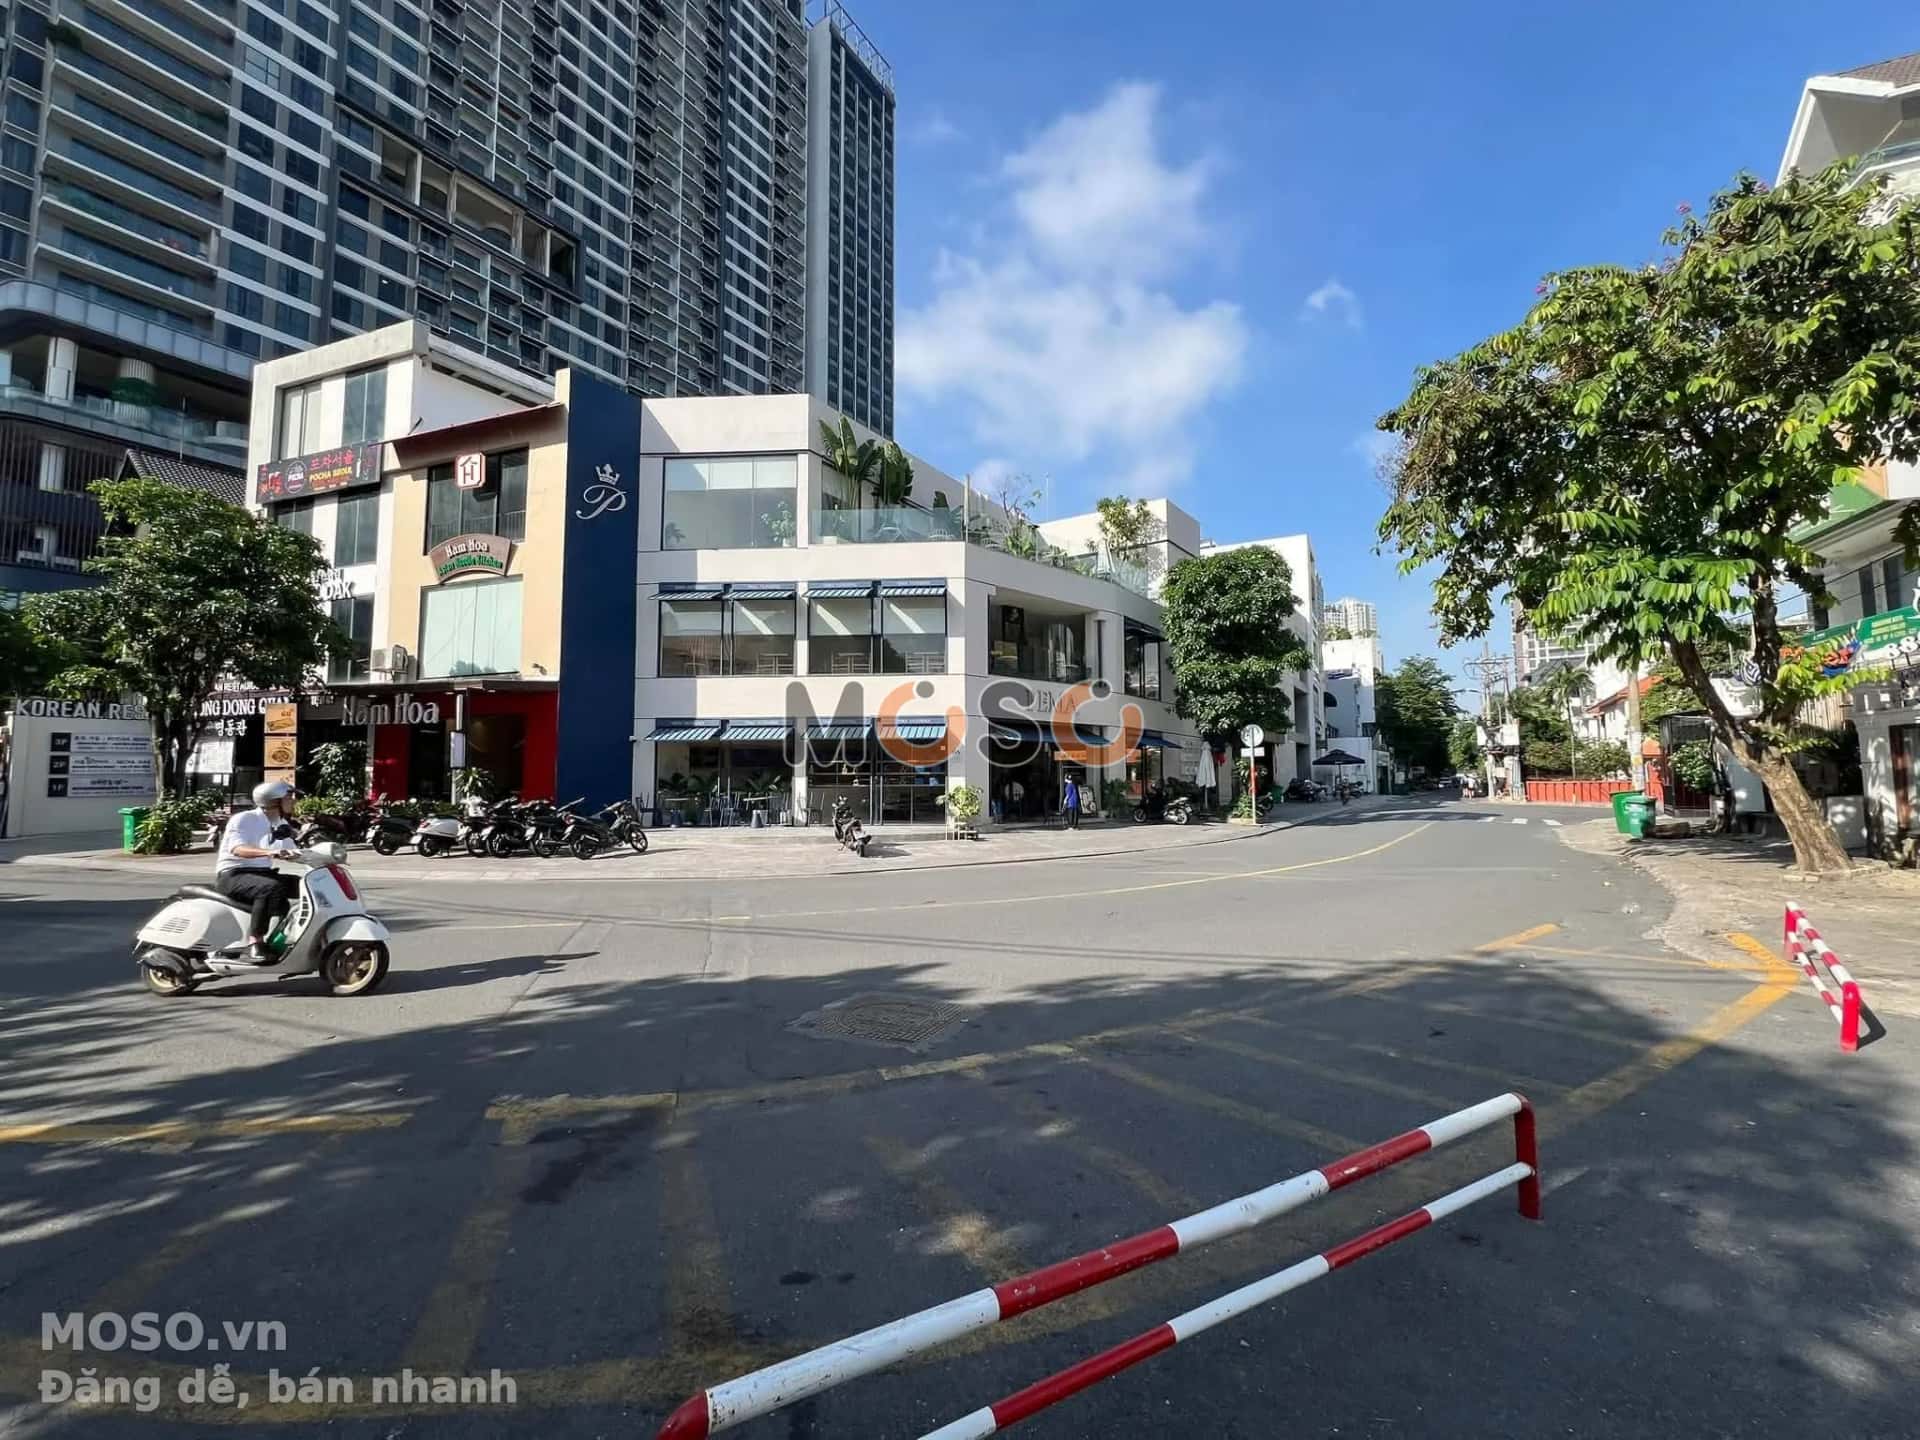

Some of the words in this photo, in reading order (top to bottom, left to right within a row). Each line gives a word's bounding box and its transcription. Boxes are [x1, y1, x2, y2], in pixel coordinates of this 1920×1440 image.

[16, 699, 100, 719] KOREAN
[222, 699, 256, 716] DONG
[392, 693, 440, 725] Hoa
